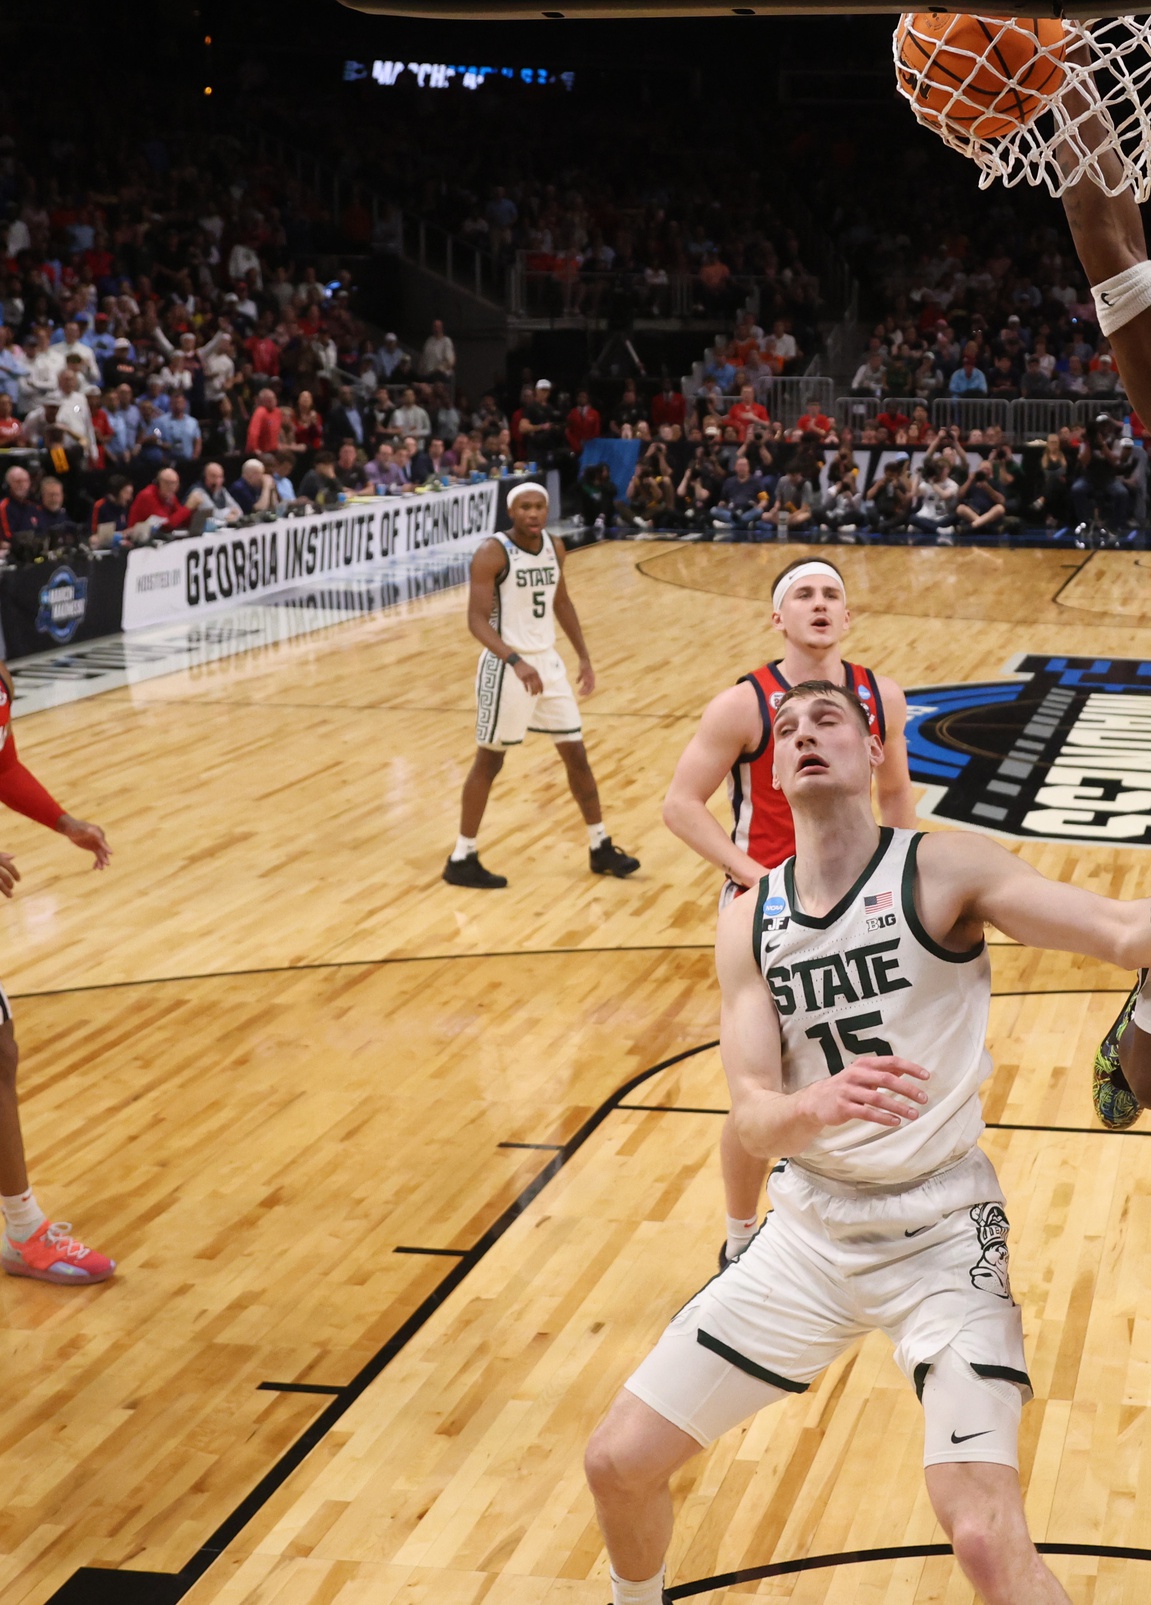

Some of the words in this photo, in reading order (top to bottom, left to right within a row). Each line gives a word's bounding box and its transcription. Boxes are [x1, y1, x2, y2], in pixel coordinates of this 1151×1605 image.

[186, 531, 278, 606] GEORGIA
[284, 513, 375, 580] INSTITUTE
[380, 510, 401, 558] OF
[405, 488, 494, 552] TECHNOLOGY
[516, 567, 555, 587] STATE
[533, 591, 545, 618] 5
[766, 903, 784, 912] NCAA
[767, 919, 785, 931] JF
[766, 937, 913, 1016] STATE
[805, 1010, 894, 1077] 15
